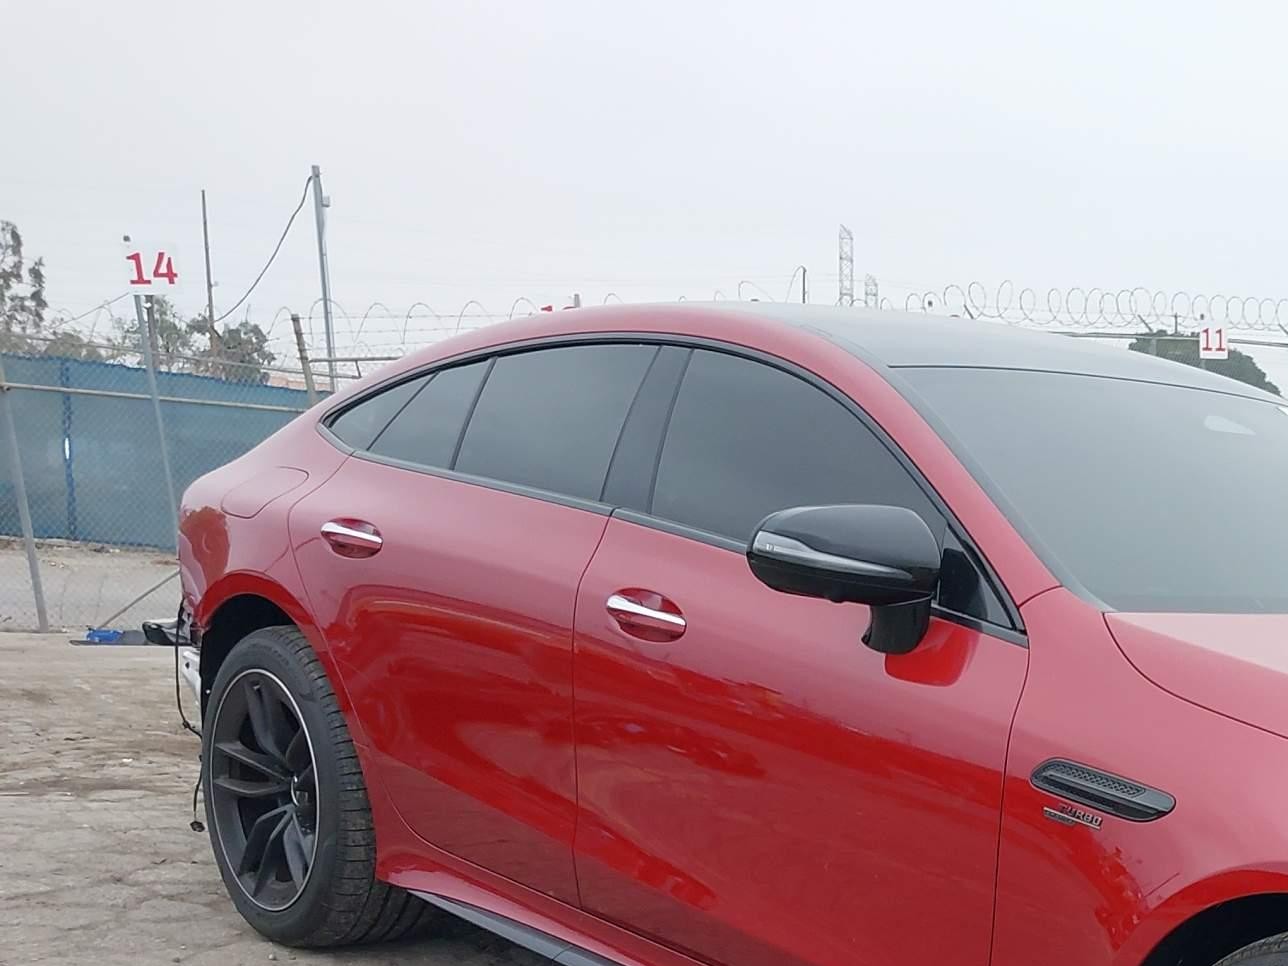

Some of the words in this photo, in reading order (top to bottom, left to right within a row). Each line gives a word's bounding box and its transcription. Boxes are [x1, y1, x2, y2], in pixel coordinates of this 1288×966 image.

[125, 251, 178, 285] 14
[1202, 328, 1226, 352] 11
[1058, 803, 1102, 826] TURBO
